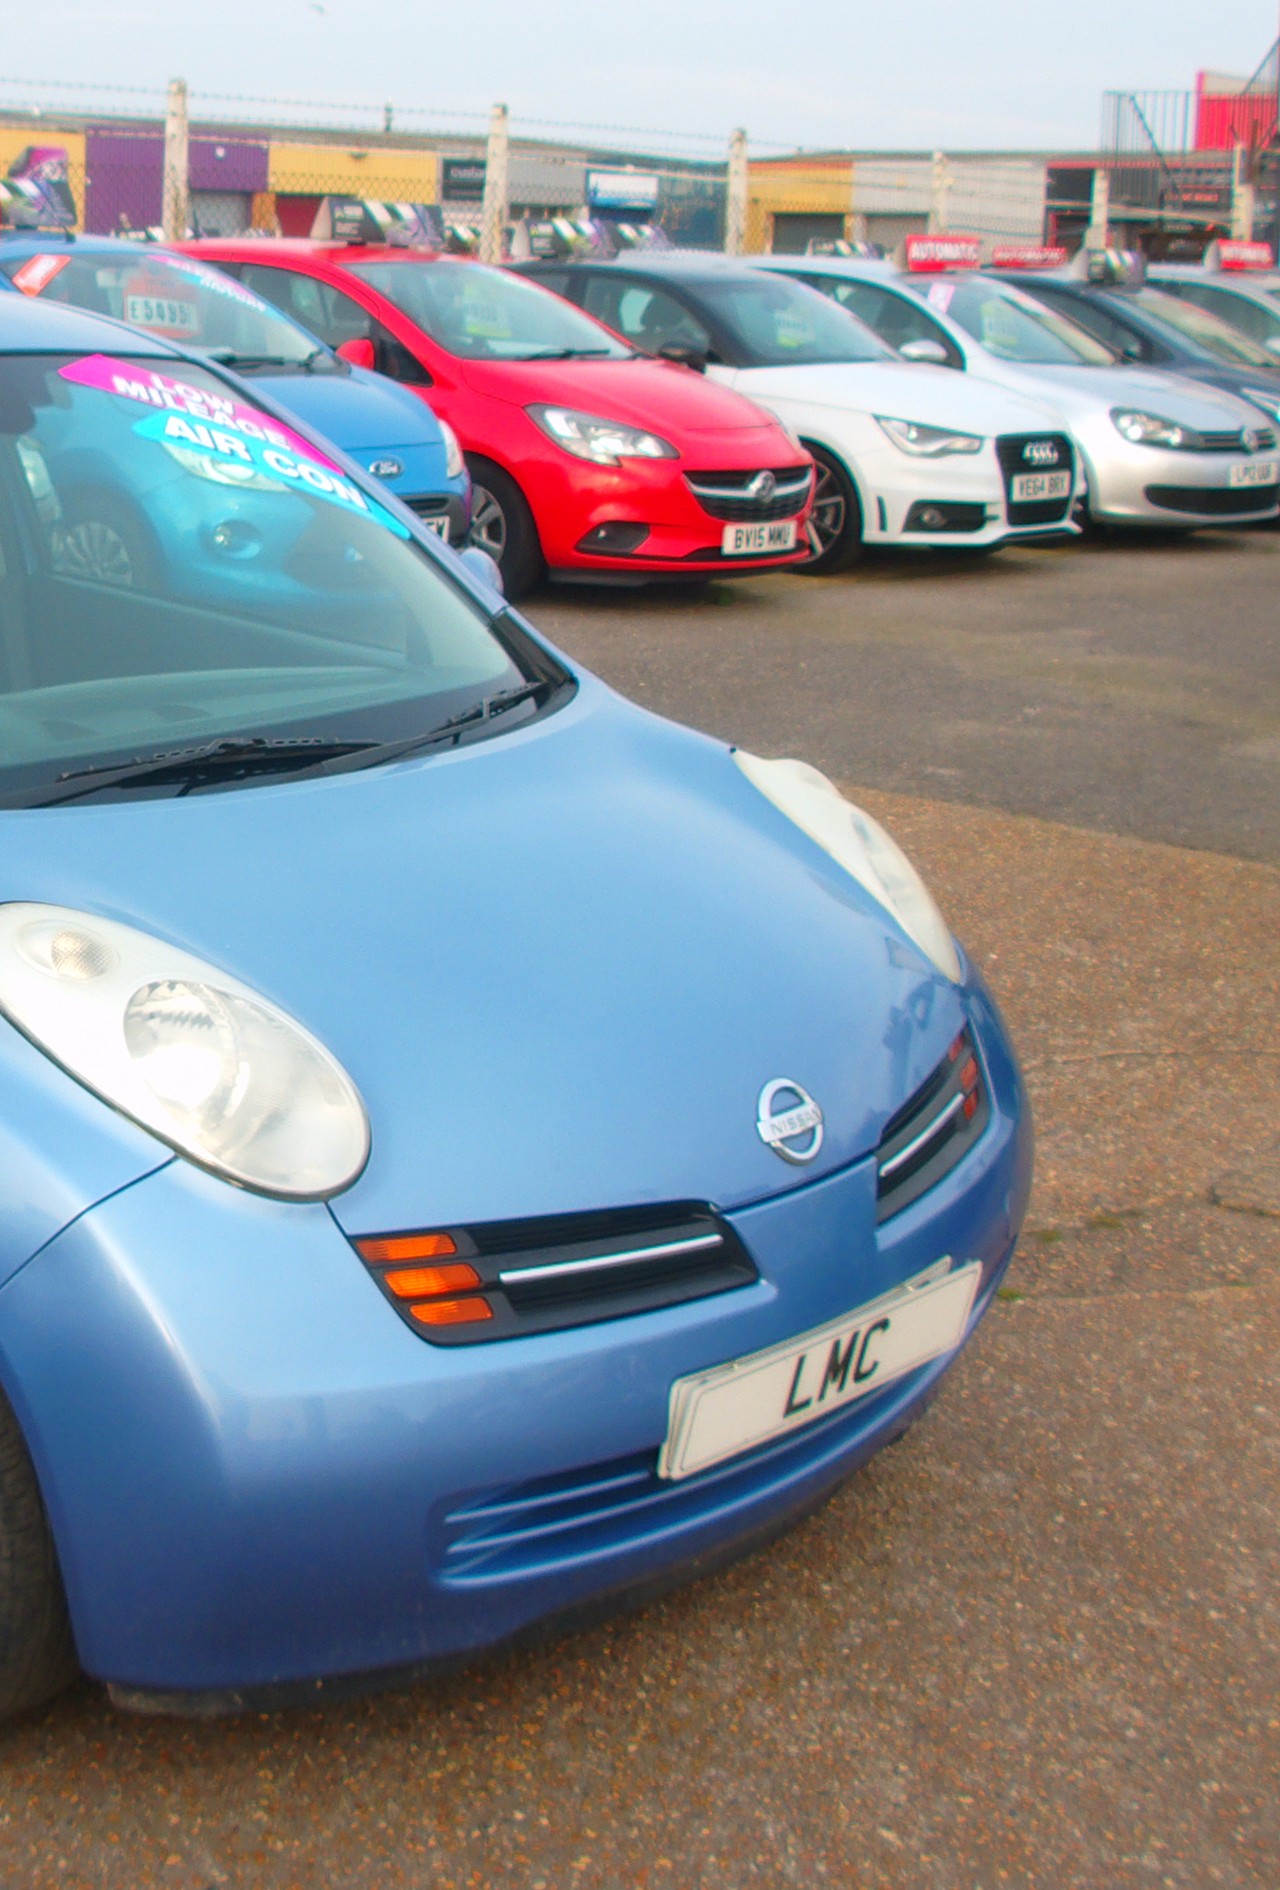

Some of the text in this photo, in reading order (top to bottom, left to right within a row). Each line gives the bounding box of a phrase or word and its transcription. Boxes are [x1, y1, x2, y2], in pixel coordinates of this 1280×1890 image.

[910, 242, 979, 262] AUTOMATIC
[112, 375, 292, 451] MILEAGE
[150, 374, 235, 414] LOW
[164, 415, 369, 511] AIR CON
[734, 527, 766, 549] BV15
[770, 1109, 821, 1137] NISSAN
[784, 1317, 890, 1418] LMC
